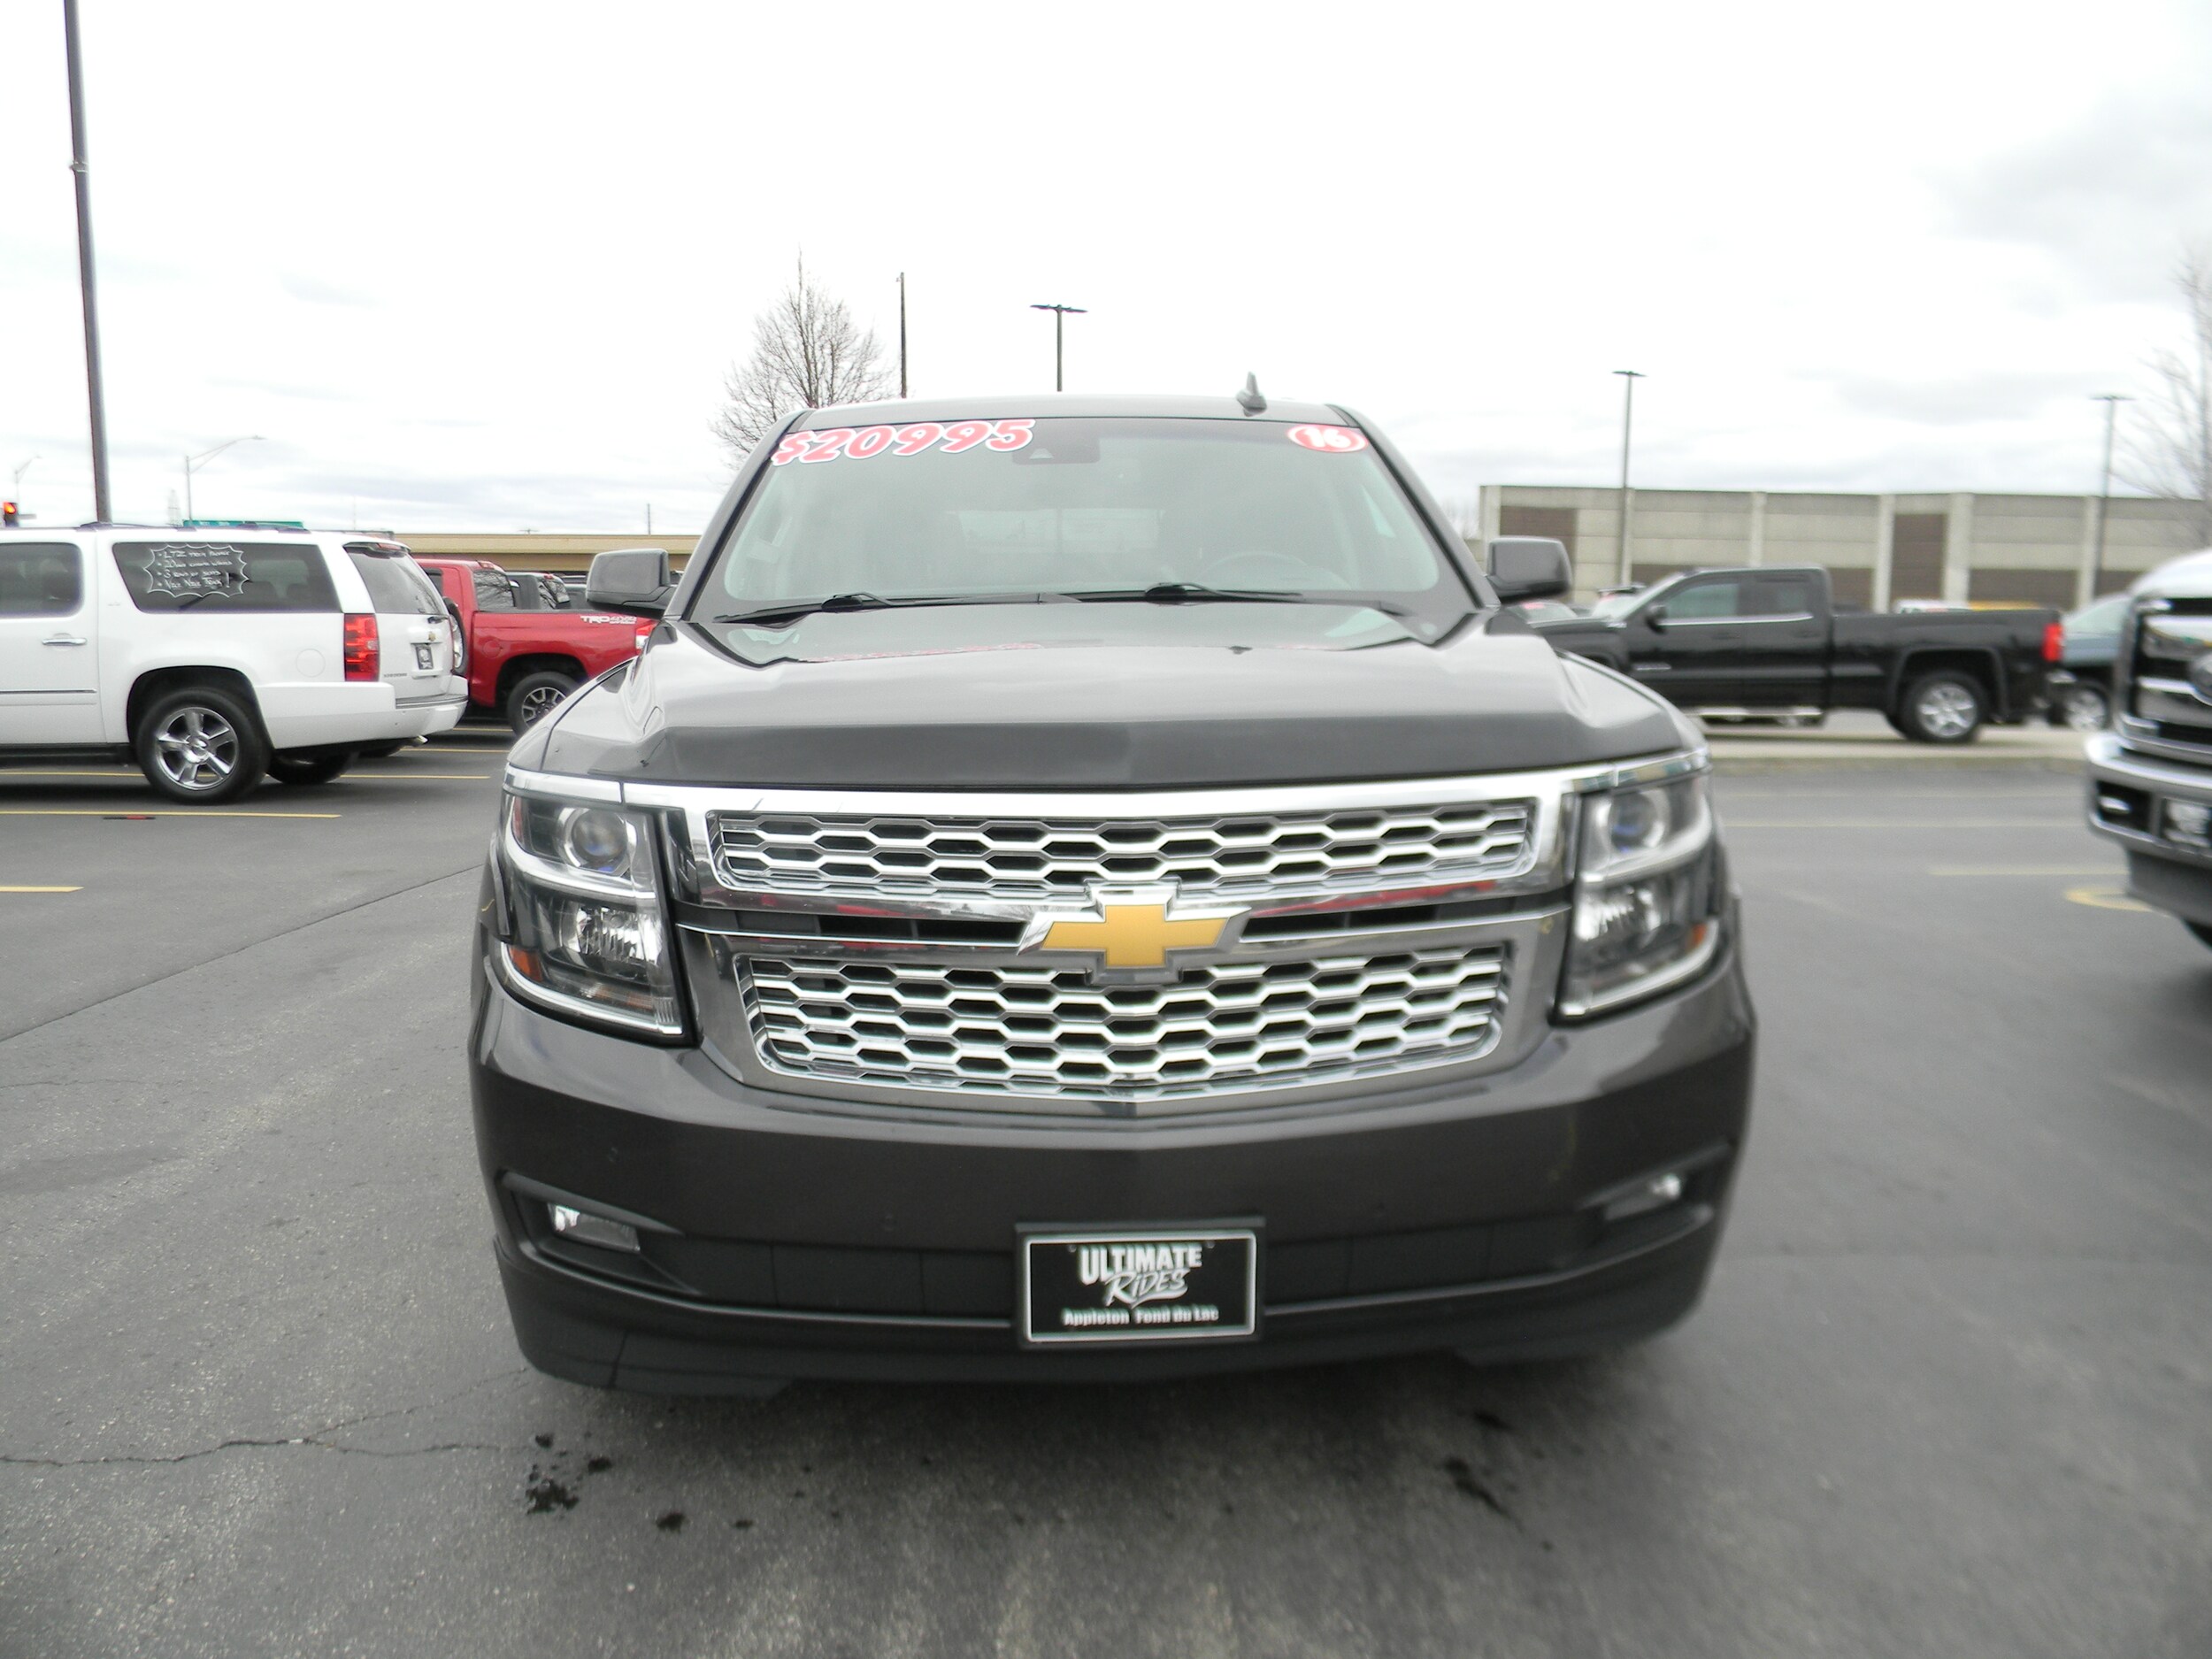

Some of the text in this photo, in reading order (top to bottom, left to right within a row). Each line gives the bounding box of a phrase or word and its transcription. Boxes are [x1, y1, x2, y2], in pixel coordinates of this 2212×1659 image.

[771, 419, 1036, 466] $20995
[1303, 426, 1351, 449] 16
[580, 615, 610, 624] TRD
[1079, 1243, 1203, 1286] ULTIMATE
